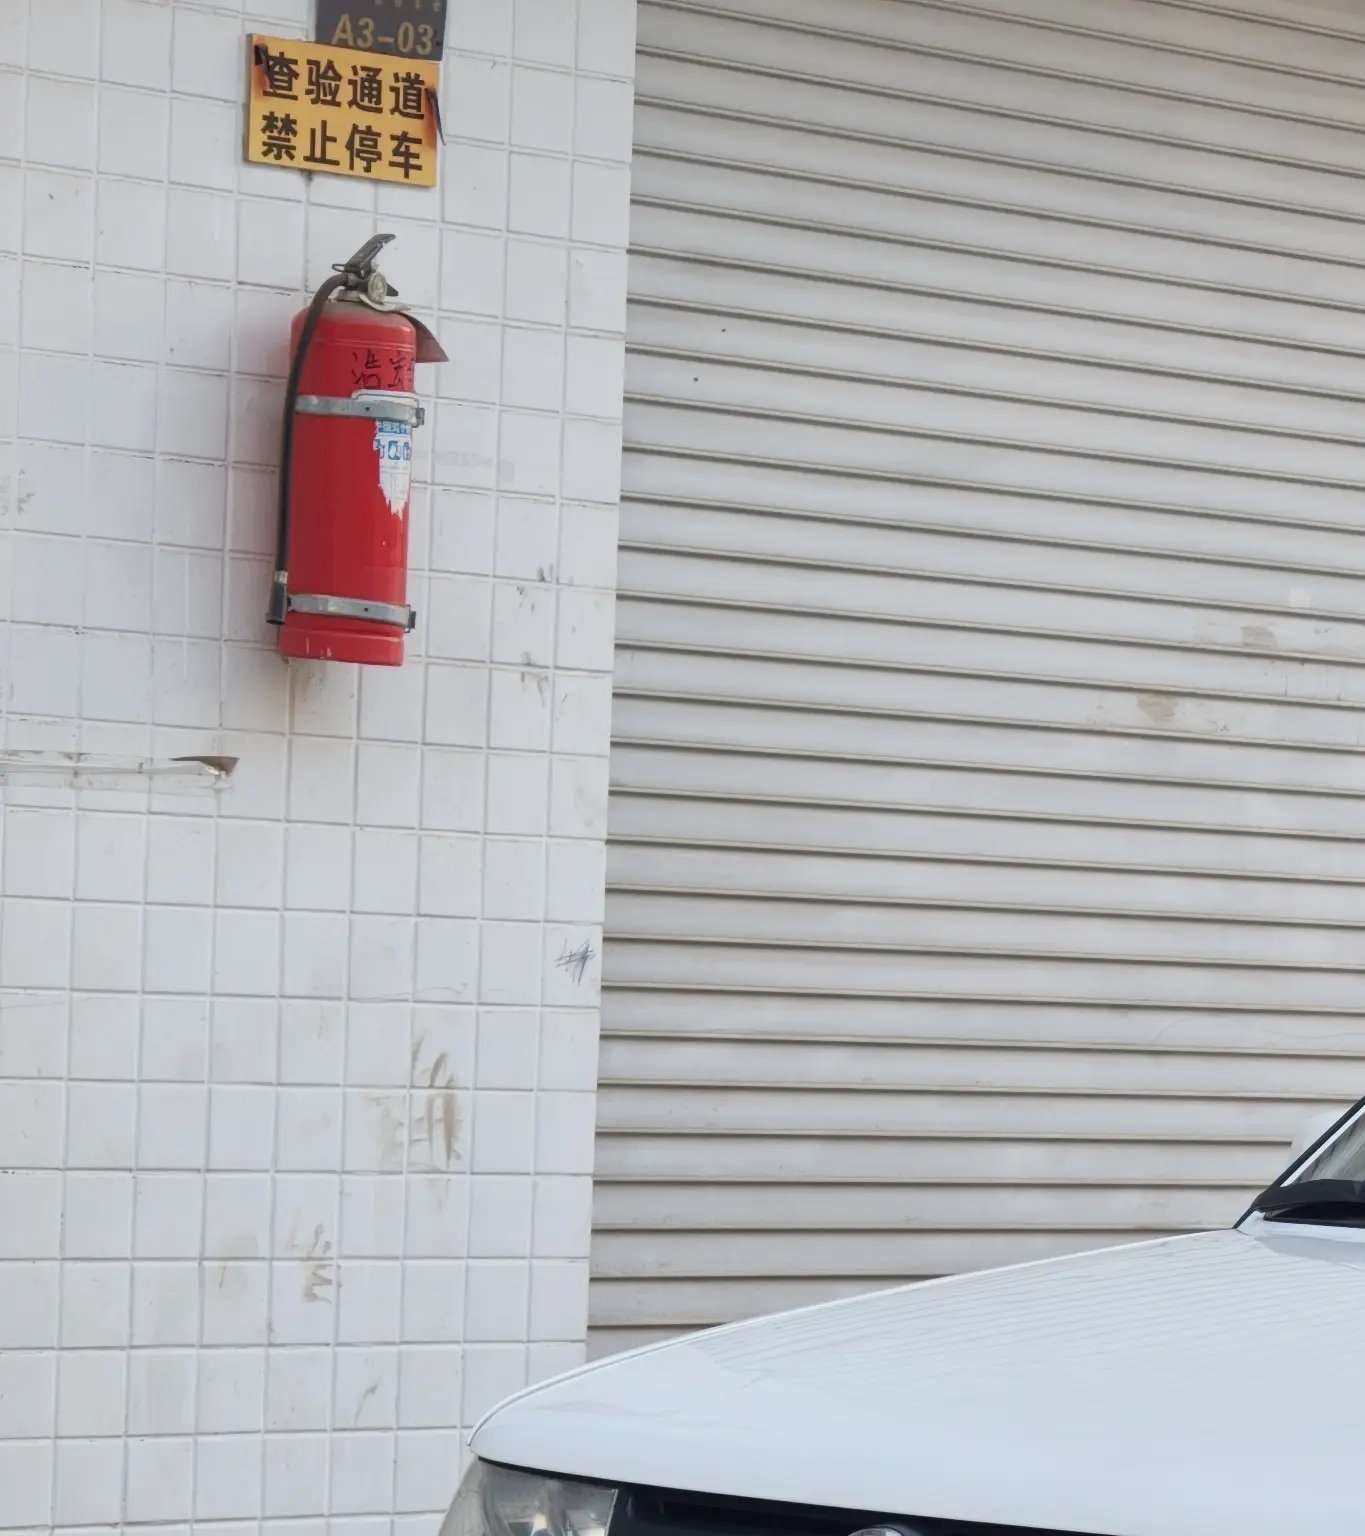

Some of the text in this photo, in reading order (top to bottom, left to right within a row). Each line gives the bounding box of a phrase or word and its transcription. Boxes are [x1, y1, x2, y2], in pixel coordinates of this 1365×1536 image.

[331, 13, 434, 55] A3-03
[262, 51, 425, 120] 查验通道
[260, 111, 423, 179] 禁止停车
